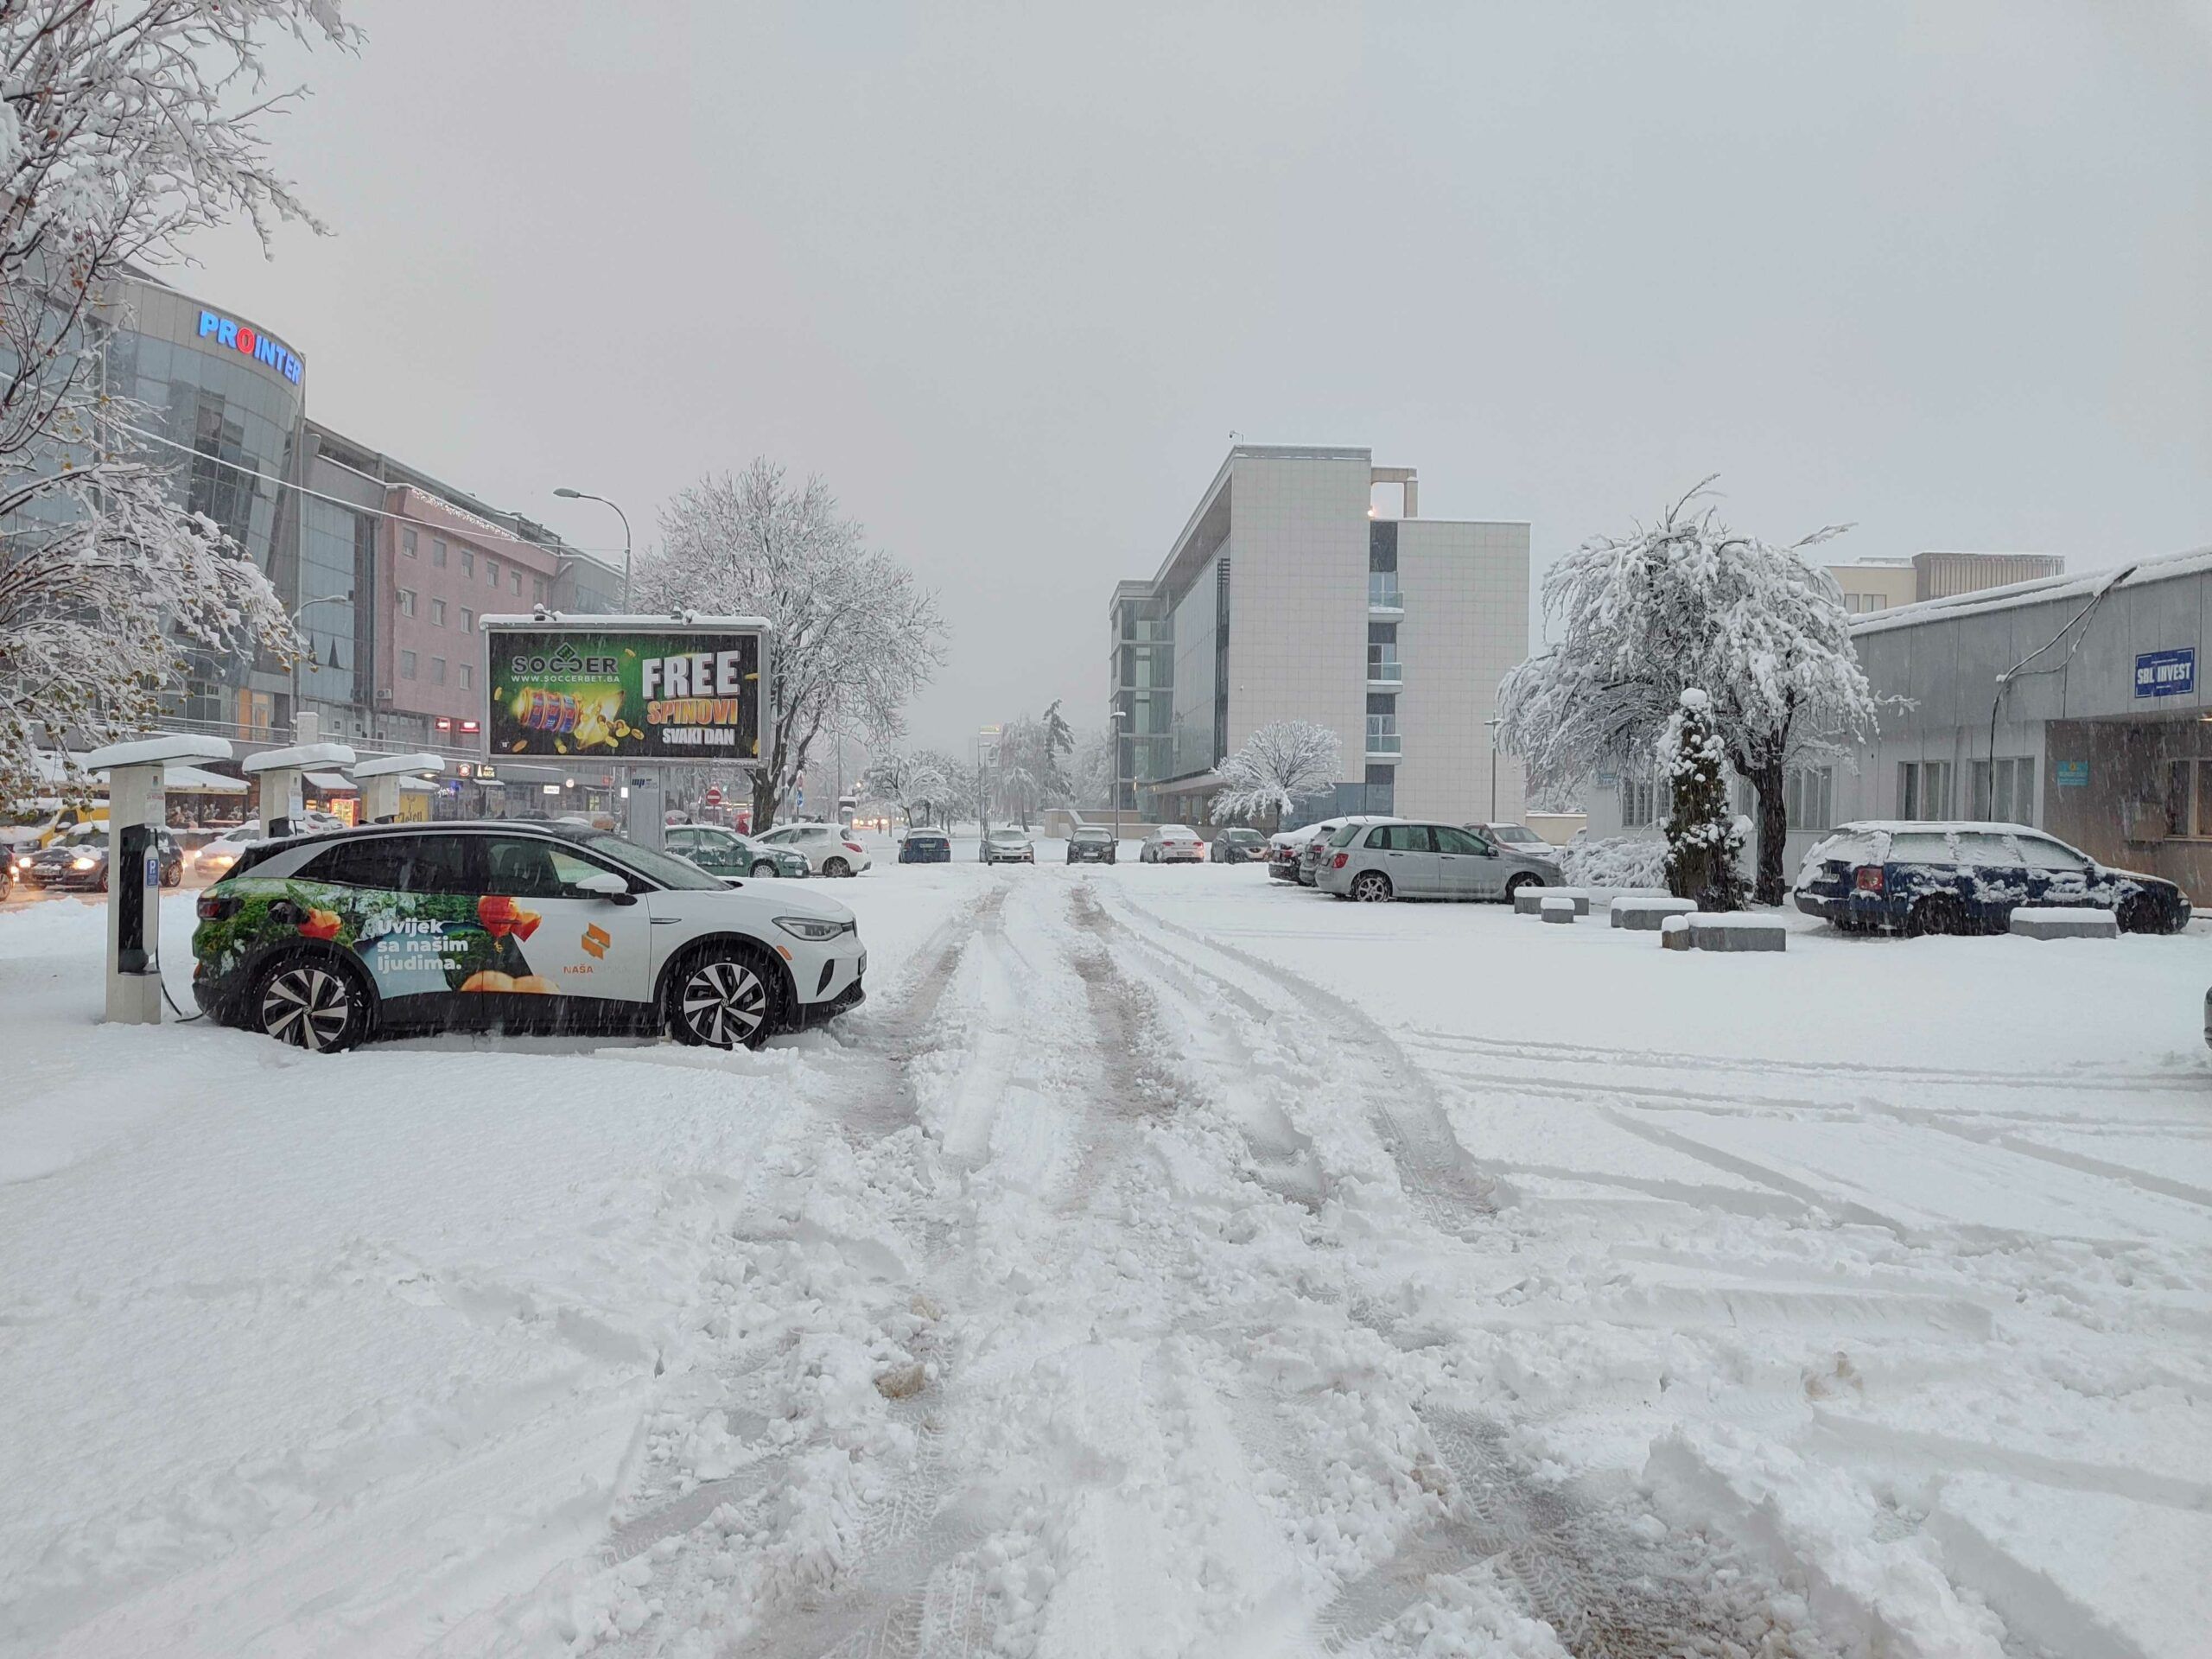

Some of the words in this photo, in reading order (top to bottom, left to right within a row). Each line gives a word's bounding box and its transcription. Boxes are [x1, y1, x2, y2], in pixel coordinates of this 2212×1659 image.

[198, 310, 301, 385] PROINTER
[512, 656, 618, 674] SOCCER
[643, 651, 741, 699] FREE
[2137, 667, 2155, 684] SBL
[2157, 663, 2191, 683] INVEST
[647, 699, 738, 724] SPINOVI
[663, 728, 702, 744] SVAKI
[704, 728, 734, 745] DAN
[378, 918, 443, 938] Uvijek
[378, 940, 399, 952] sa
[406, 936, 468, 952] našim
[378, 954, 461, 974] ljudima.
[563, 963, 594, 974] NAŠA
